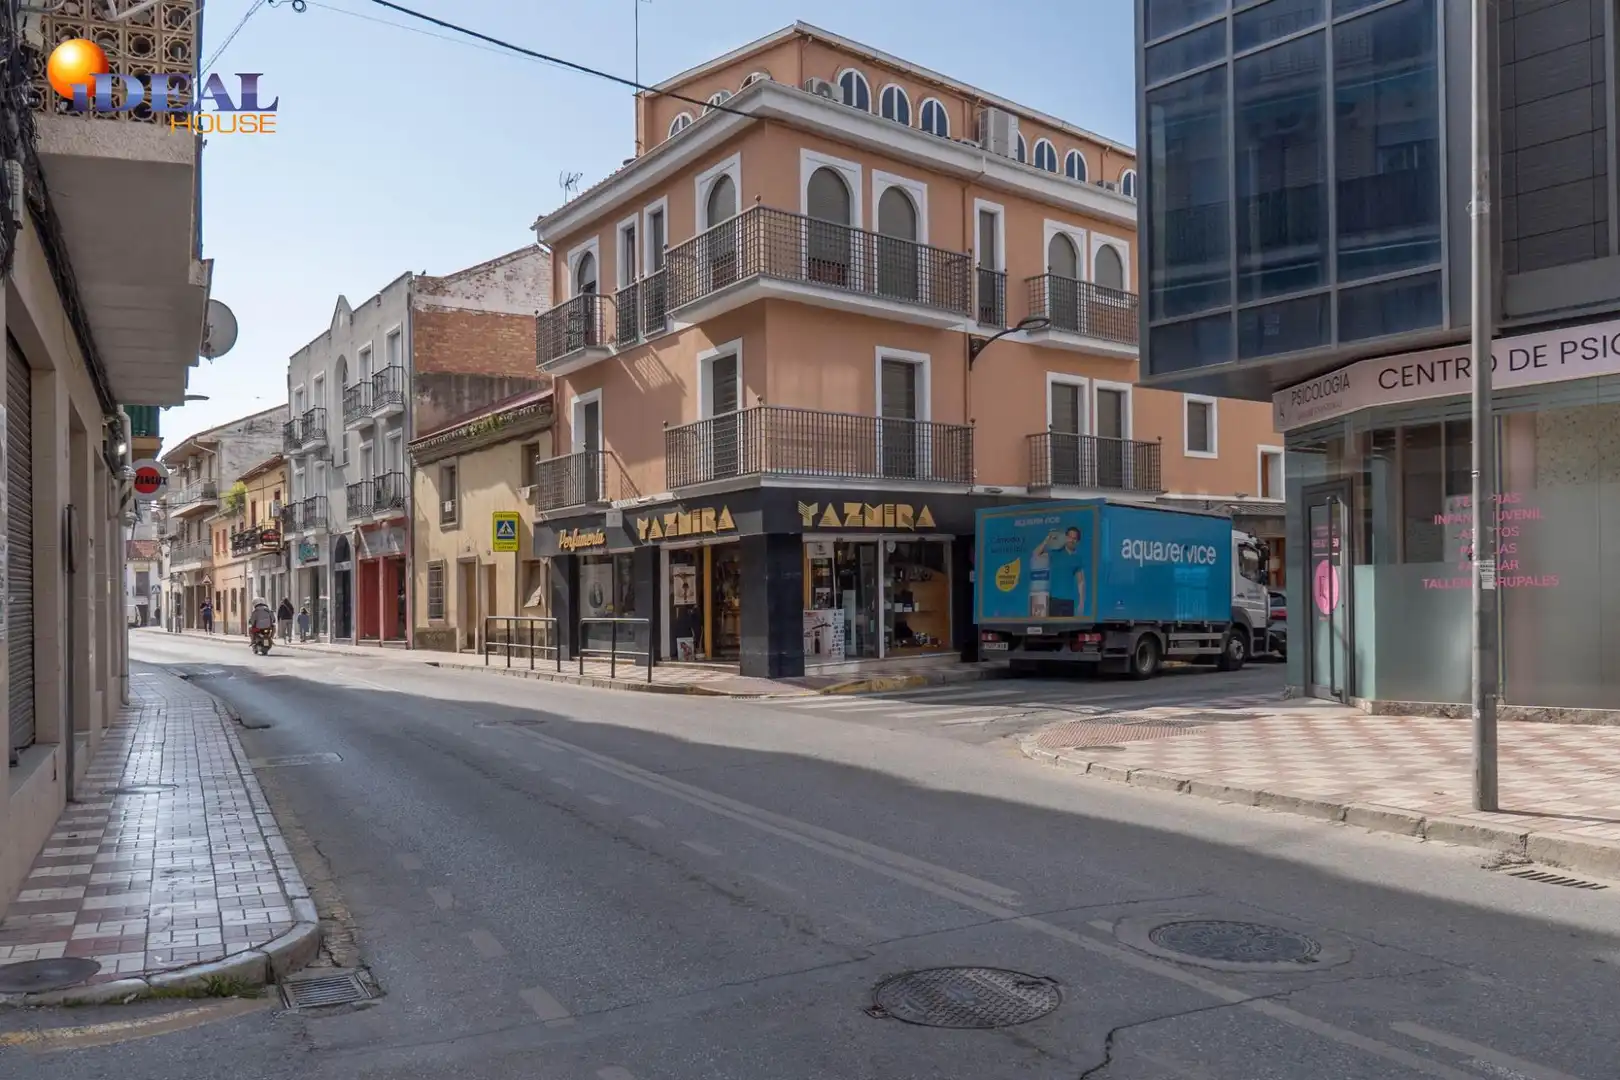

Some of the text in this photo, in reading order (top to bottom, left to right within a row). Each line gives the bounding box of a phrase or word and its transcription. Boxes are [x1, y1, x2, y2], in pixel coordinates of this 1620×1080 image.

[1378, 355, 1498, 390] CENTR
[1509, 344, 1548, 372] DE
[636, 504, 737, 540] YAZMIRA
[797, 500, 937, 531] YAZMIRA
[1121, 538, 1217, 568] aquaservice
